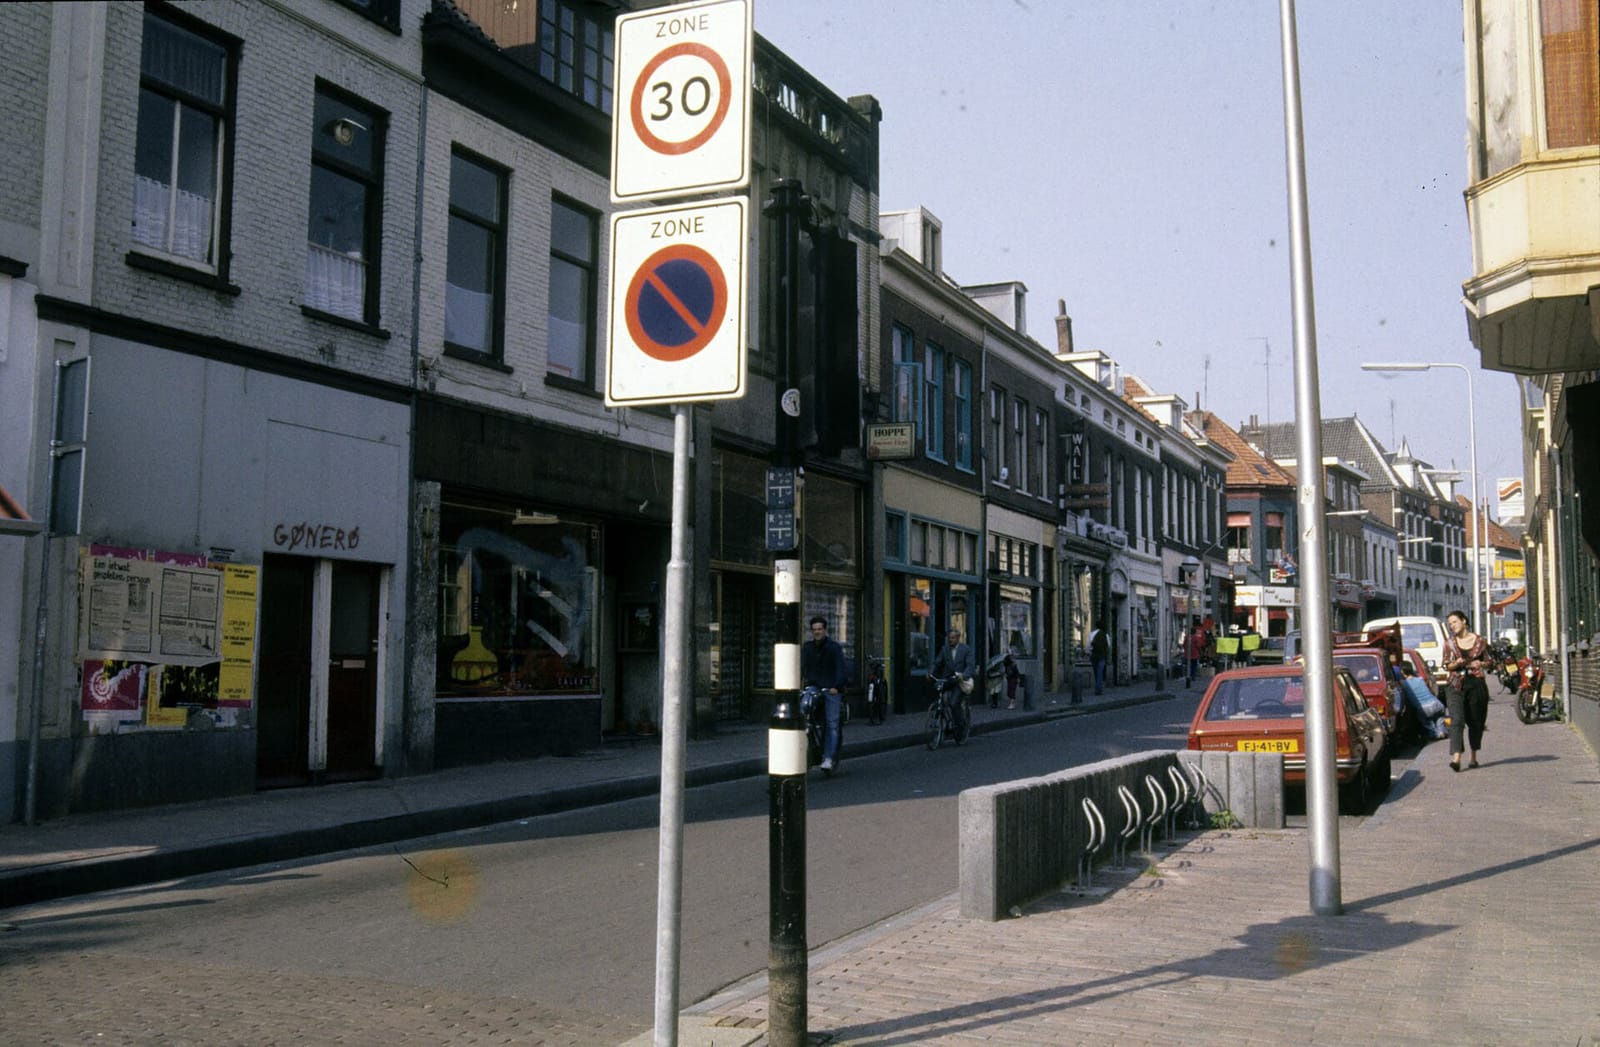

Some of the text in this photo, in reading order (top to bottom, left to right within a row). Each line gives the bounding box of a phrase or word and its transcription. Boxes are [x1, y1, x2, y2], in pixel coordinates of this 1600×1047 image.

[656, 14, 709, 38] ZONE
[651, 77, 711, 121] 30
[651, 216, 705, 238] ZONE
[874, 428, 907, 437] HOPPE
[1072, 433, 1083, 480] WALL
[1244, 741, 1290, 751] FJ-41-BV
